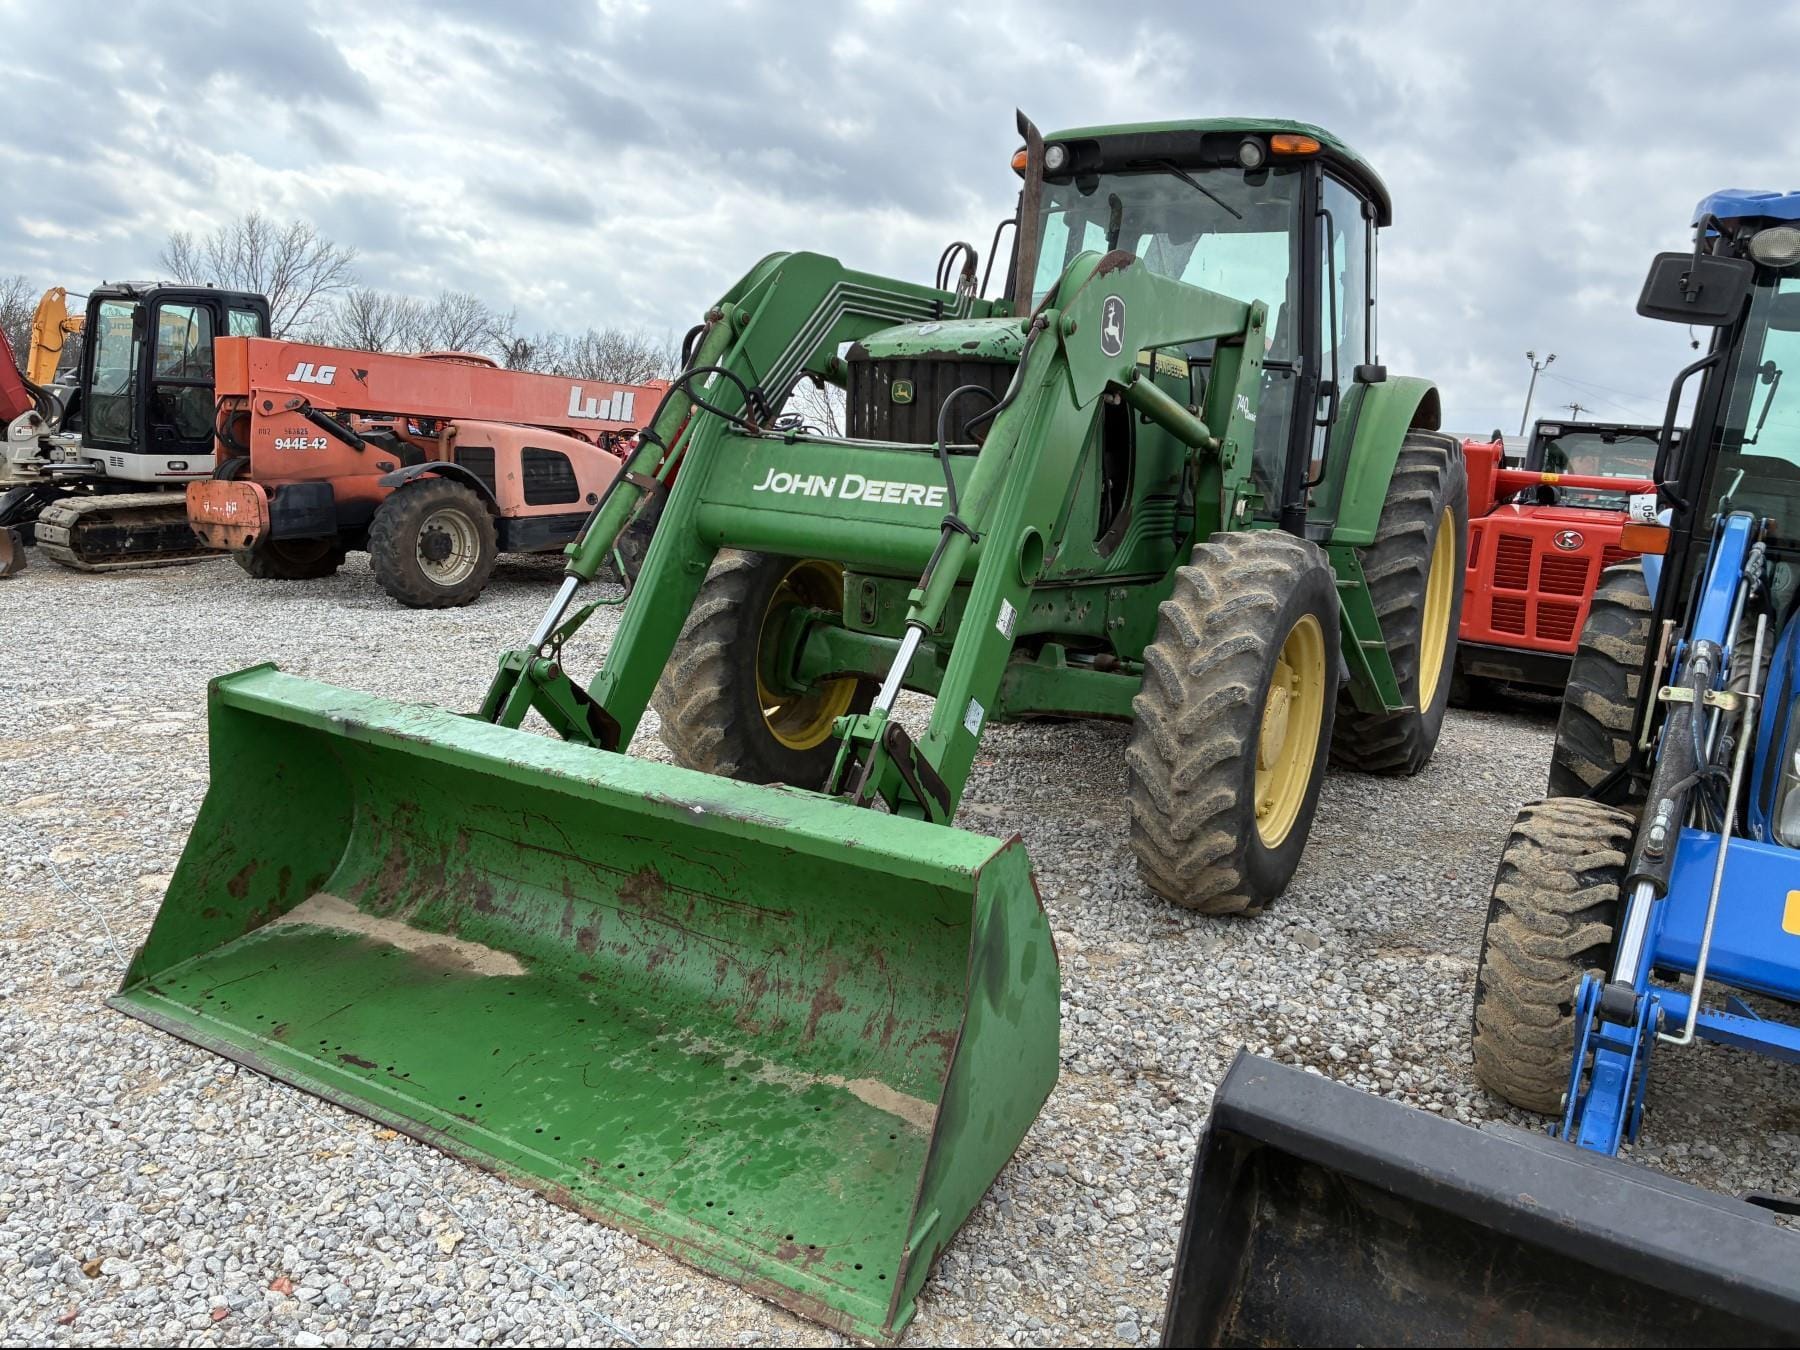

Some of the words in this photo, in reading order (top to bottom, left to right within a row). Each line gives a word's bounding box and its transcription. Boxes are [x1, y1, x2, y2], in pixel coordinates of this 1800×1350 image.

[286, 362, 337, 385] JLG
[567, 386, 635, 422] Lull
[275, 437, 328, 450] 944E-42
[753, 468, 837, 498] JOHN
[838, 473, 948, 508] DEERE
